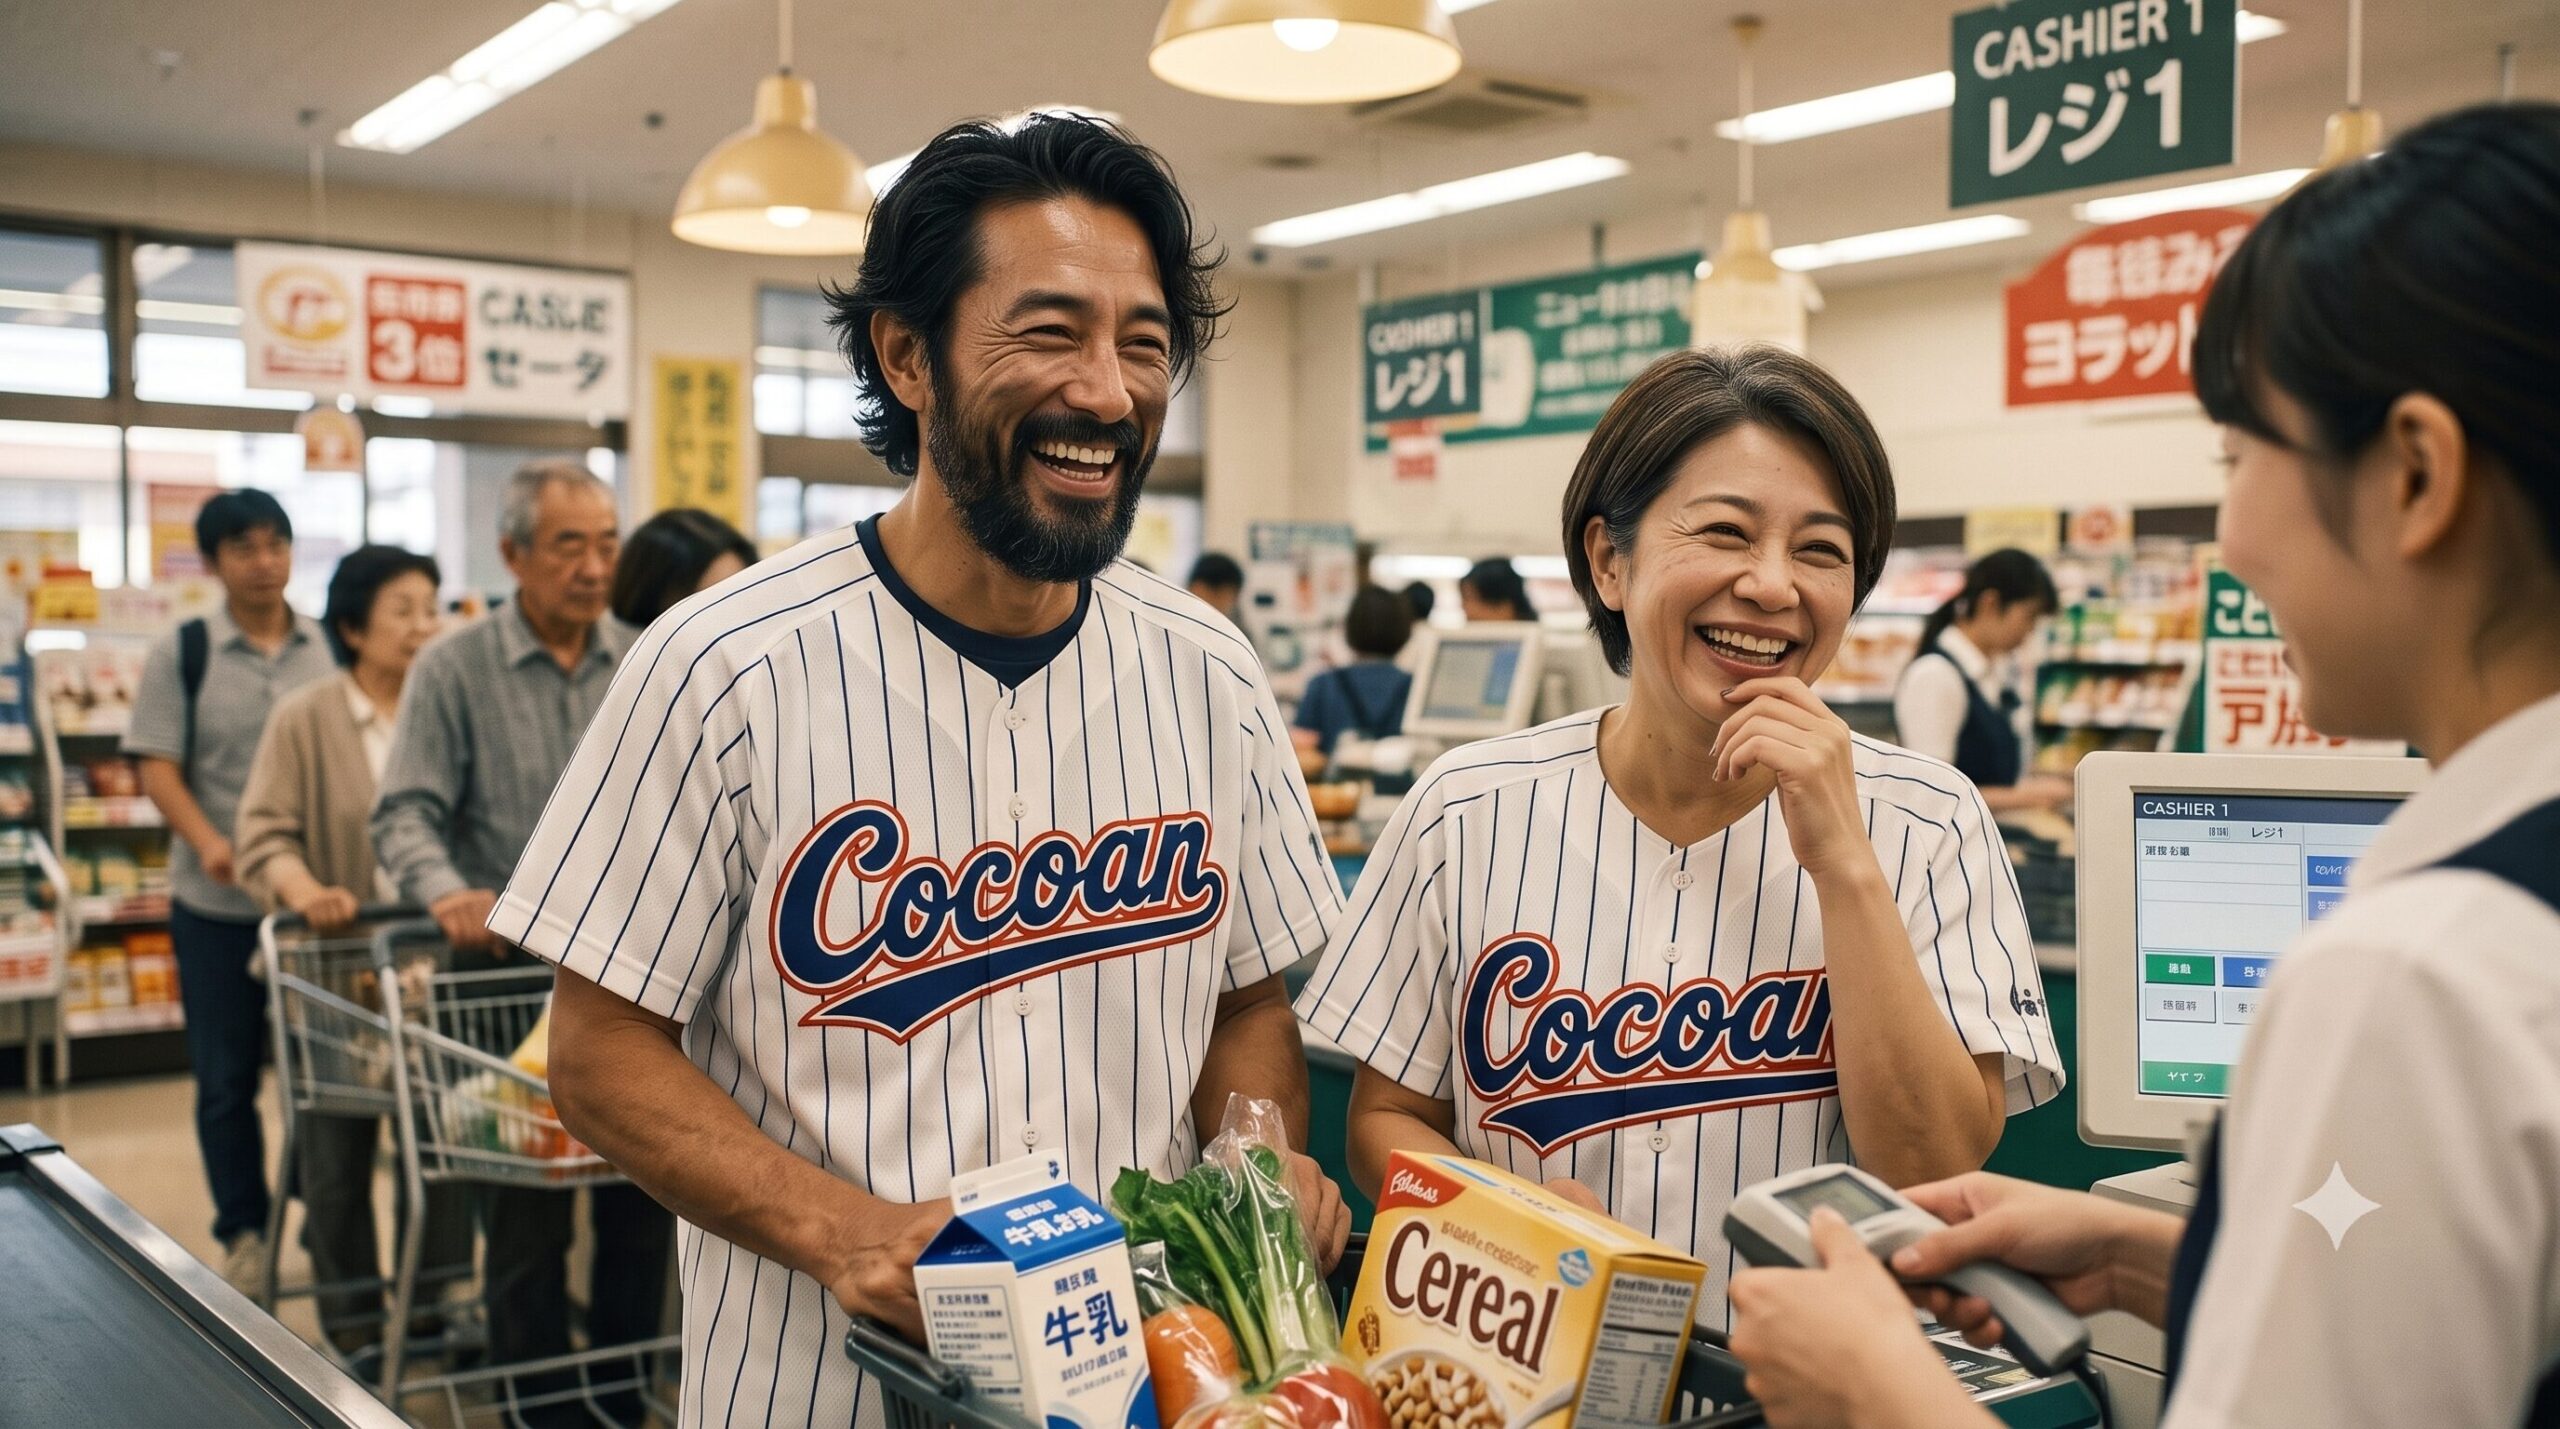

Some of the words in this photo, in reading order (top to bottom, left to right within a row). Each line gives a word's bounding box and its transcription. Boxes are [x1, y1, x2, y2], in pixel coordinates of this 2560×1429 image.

[1973, 0, 2169, 79] CASHIER
[1989, 58, 2182, 177] レジ1
[1375, 347, 1467, 412] レジ1
[2214, 588, 2282, 636] こと
[2143, 801, 2216, 817] CASHIER
[2221, 803, 2229, 817] 1
[769, 799, 1228, 995] Cocoan
[1045, 1290, 1129, 1358] 牛乳
[1385, 1220, 1560, 1374] Cereal
